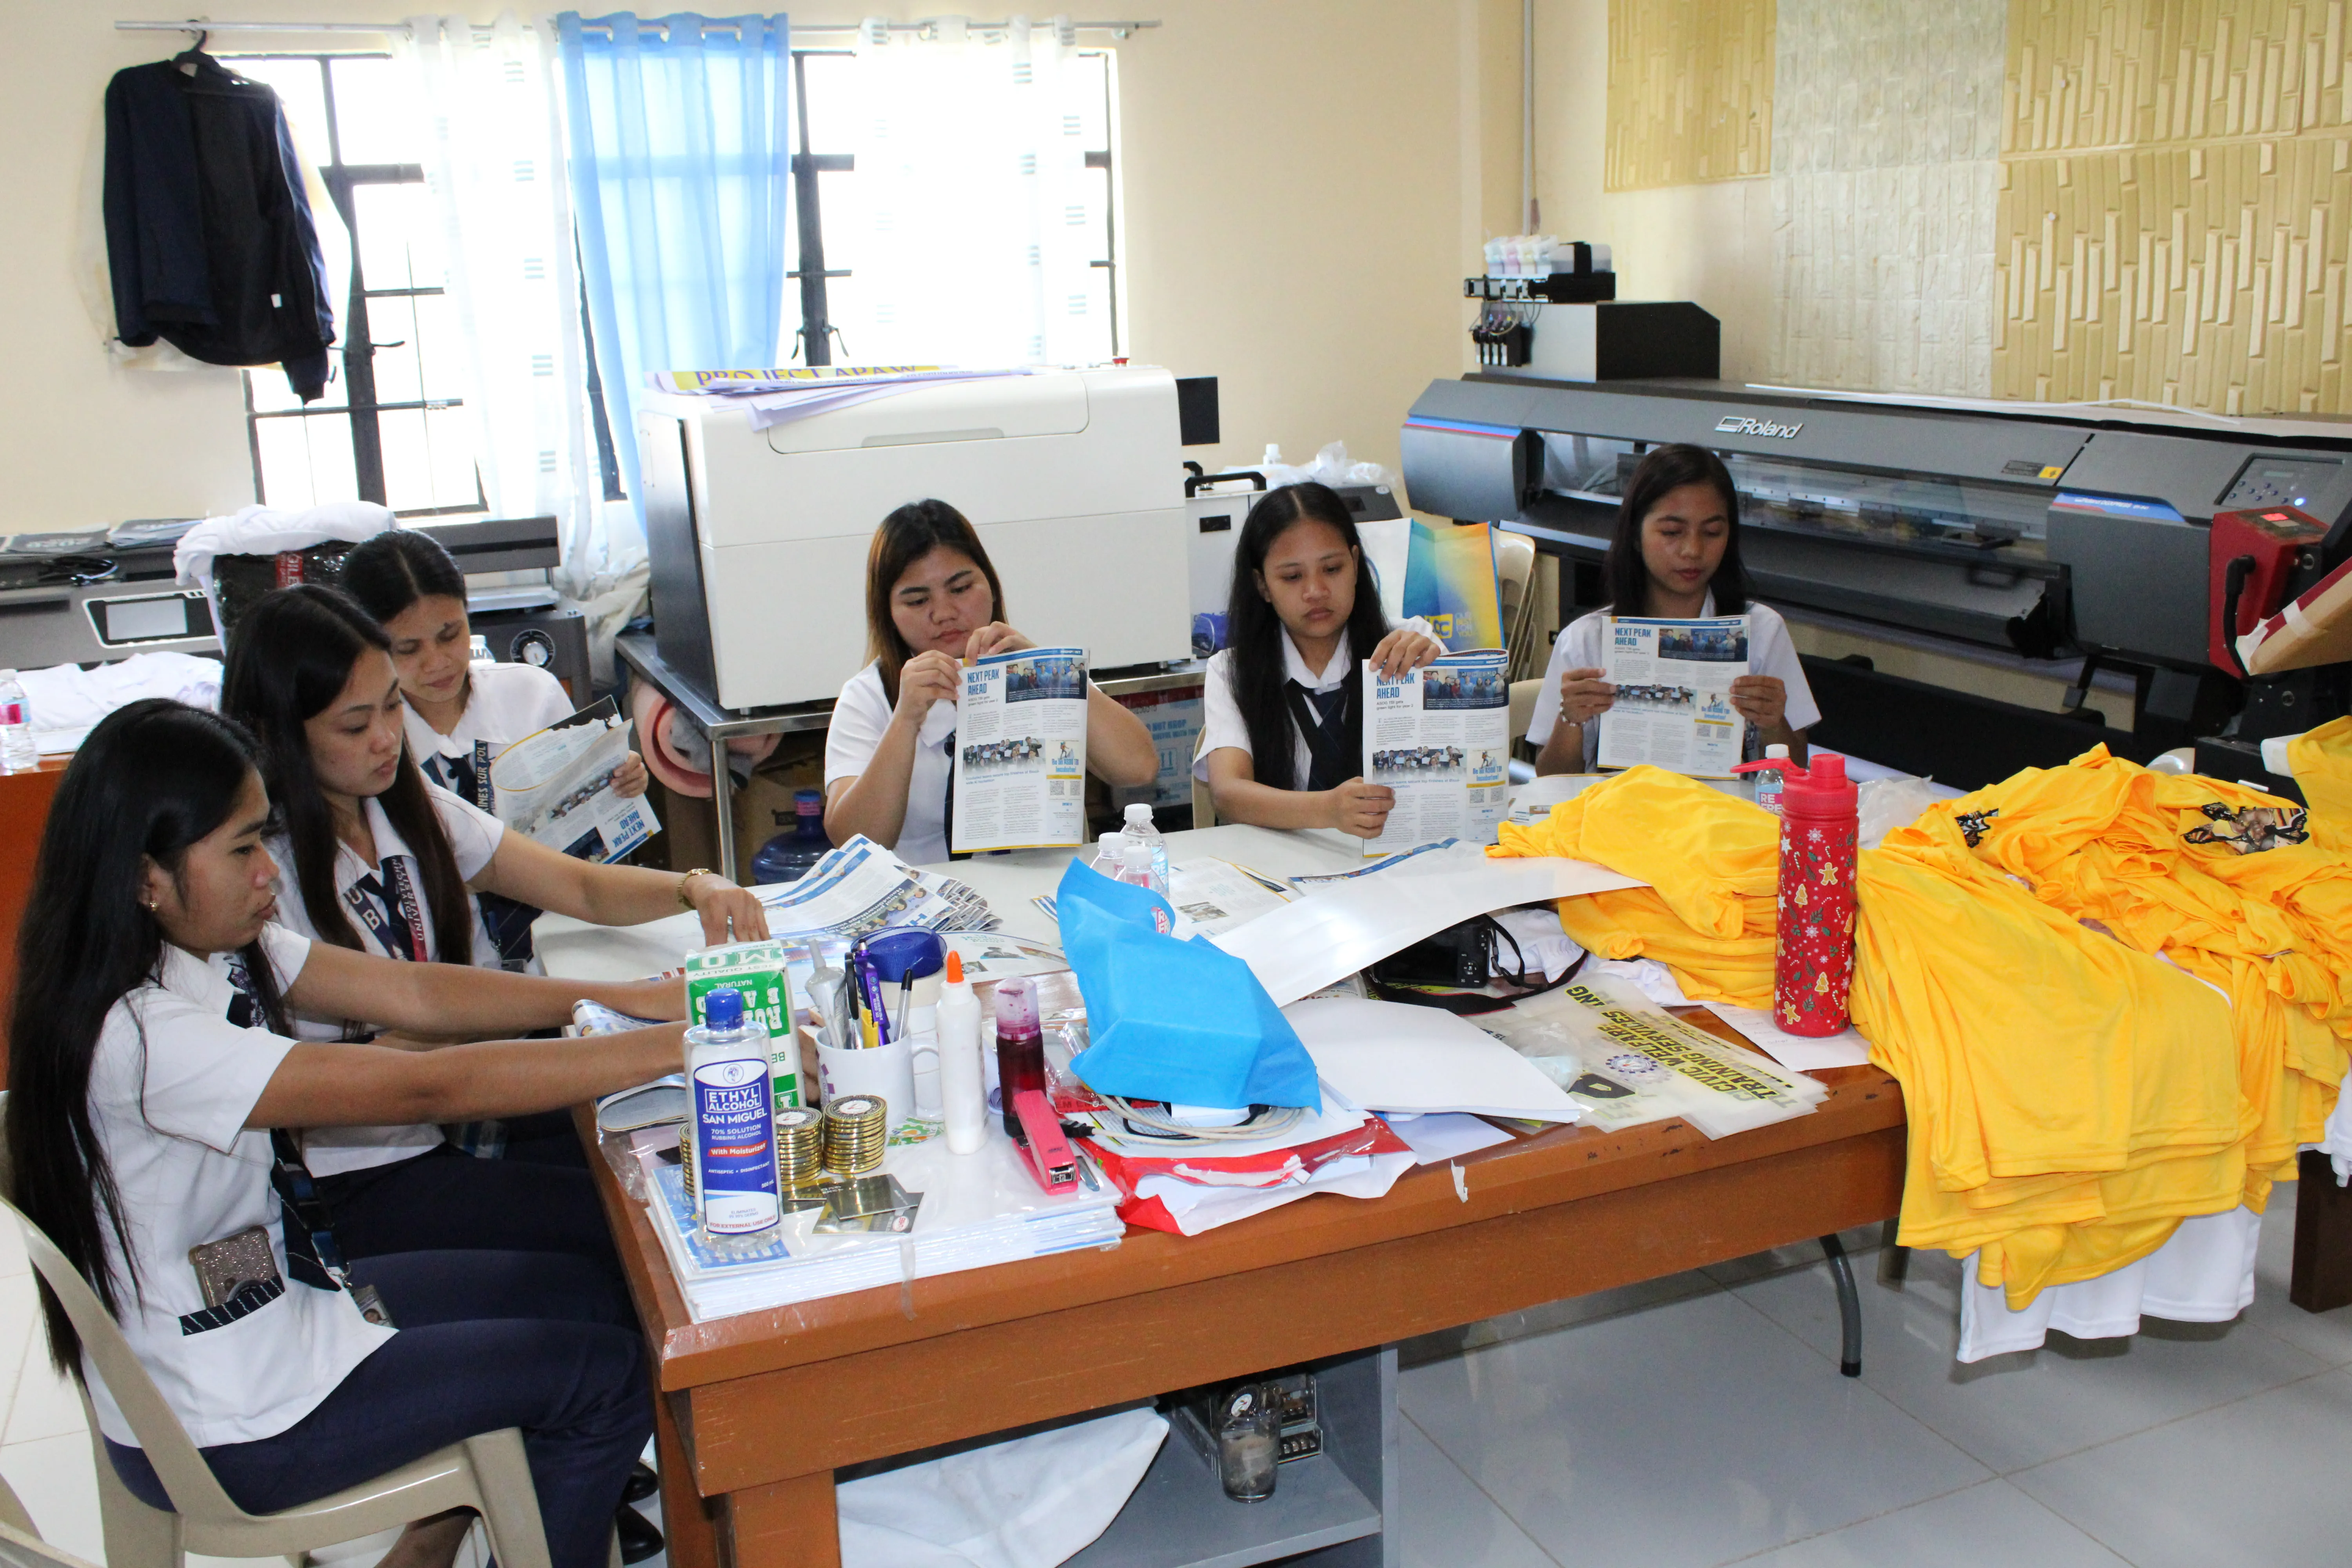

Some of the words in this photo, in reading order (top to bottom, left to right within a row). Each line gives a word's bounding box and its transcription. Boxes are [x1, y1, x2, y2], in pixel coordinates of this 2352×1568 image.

[1737, 418, 1804, 439] Roland
[1615, 628, 1632, 636] NEXT
[1634, 628, 1651, 637] PEAK
[1615, 637, 1637, 646] AHEAD
[967, 671, 983, 684] NEXT
[984, 669, 999, 681] PEAK
[967, 683, 987, 696] AHEAD
[1376, 687, 1399, 699] AHEAD
[477, 766, 487, 785] SUR
[1760, 793, 1775, 803] RE
[619, 810, 641, 830] AHEAD
[627, 819, 646, 837] NEXT
[612, 831, 630, 848] PEAK
[398, 862, 424, 941] UNIVERSITY
[862, 903, 885, 921] powers
[693, 966, 743, 977] QUALITY
[714, 979, 753, 989] NATURAL
[696, 987, 779, 1013] BAD
[1601, 1011, 1692, 1052] SERVICES
[1597, 1024, 1687, 1066] WELFARE
[1678, 1066, 1738, 1092] CIVIC
[1681, 1053, 1778, 1100] TRAINING
[709, 1086, 759, 1103] ETHYL
[708, 1099, 760, 1112] ALCOHOL
[702, 1113, 725, 1124] SAN
[727, 1107, 768, 1124] MIGUEL
[726, 1123, 762, 1134] SOLUTION
[737, 1131, 762, 1140] ALCOHOL
[729, 1142, 766, 1155] Moisturizer
[740, 1161, 770, 1174] DISINFECTANT
[721, 1221, 751, 1230] EXTERNAL
[752, 1219, 763, 1227] USE
[764, 1215, 776, 1225] ONLY
